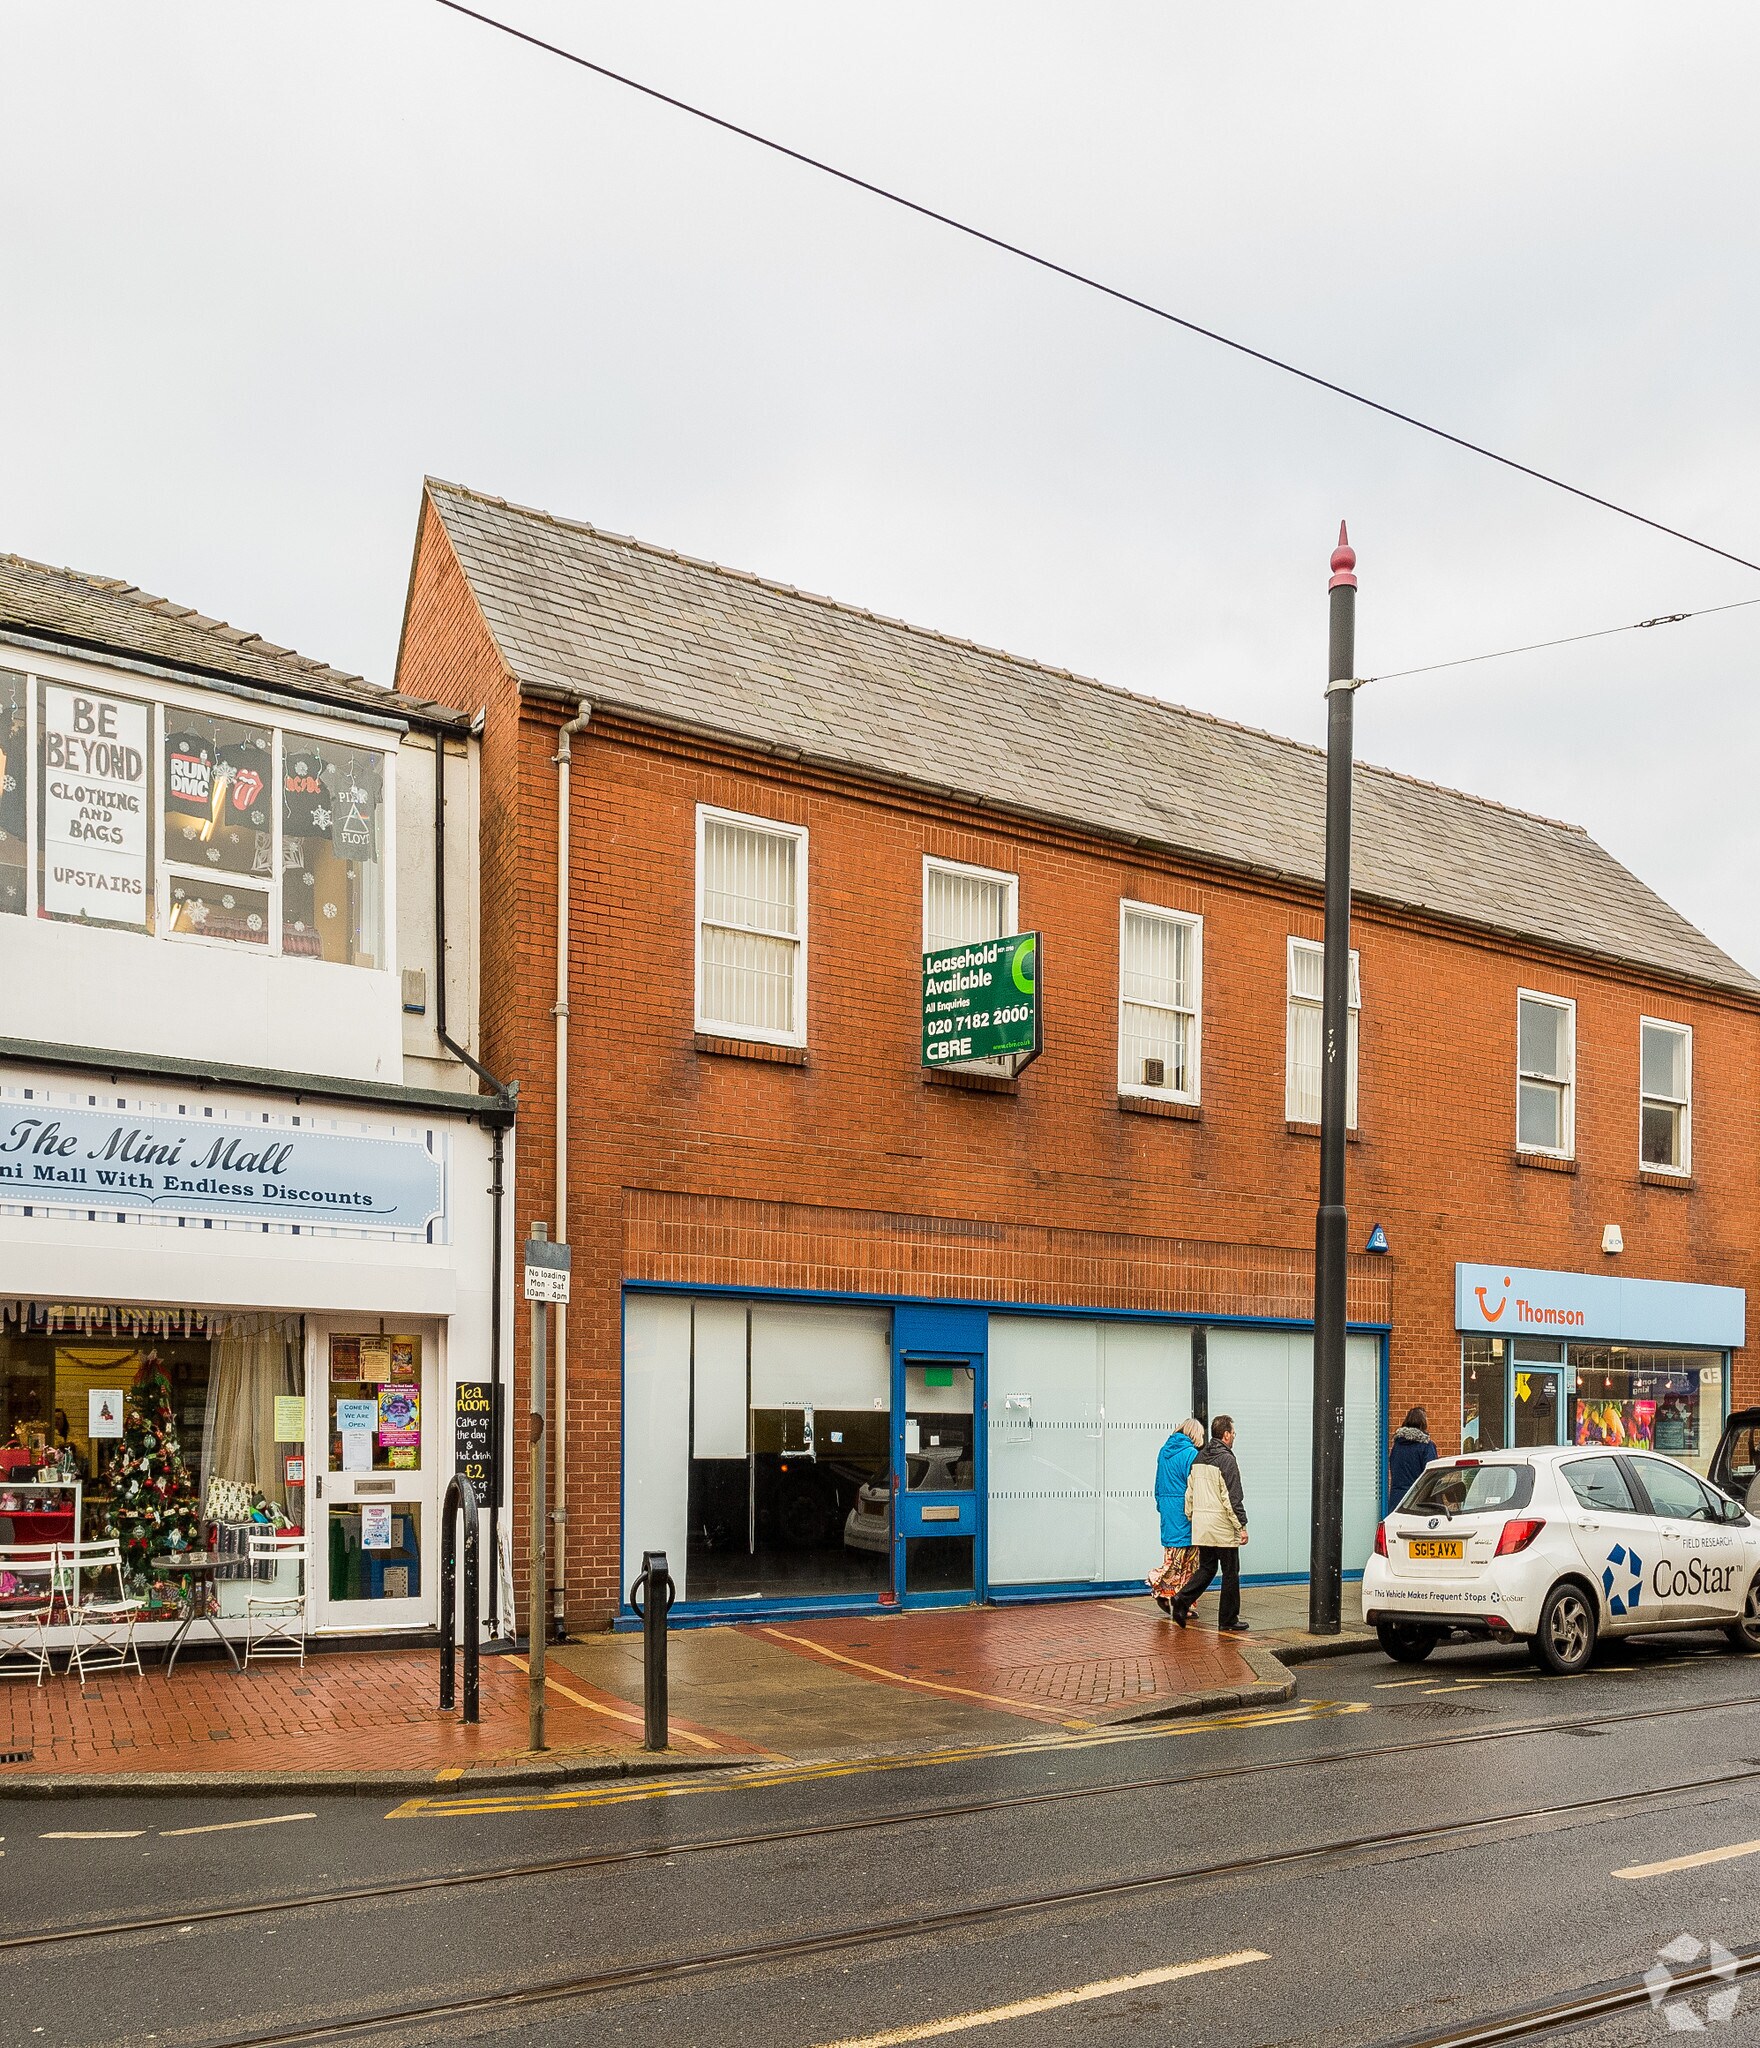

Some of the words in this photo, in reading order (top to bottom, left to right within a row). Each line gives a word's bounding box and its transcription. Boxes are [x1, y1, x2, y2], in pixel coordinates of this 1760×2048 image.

[73, 697, 118, 739] BE
[46, 731, 144, 782] BEYOND
[170, 758, 211, 779] RUN
[170, 774, 209, 797] DMC
[50, 782, 140, 813] CLOTHING
[79, 807, 113, 823] AND
[69, 819, 124, 844] BAGS
[53, 866, 143, 895] UPSTAIRS
[926, 944, 998, 975] Leasehold
[925, 968, 993, 997] Available
[925, 1003, 936, 1014] All
[937, 998, 971, 1012] Enquiries
[928, 1019, 953, 1036] 020
[955, 1013, 990, 1031] 7182
[993, 1006, 1028, 1025] 2000
[926, 1037, 972, 1060] CBRE
[0, 1119, 78, 1157] The
[87, 1127, 187, 1166] Mini
[191, 1137, 294, 1175] Mall
[33, 1164, 88, 1184] Mall
[96, 1170, 154, 1189] With
[163, 1176, 254, 1196] Endless
[262, 1183, 373, 1206] Discounts
[528, 1269, 539, 1277] No
[541, 1270, 566, 1281] loading
[530, 1279, 545, 1287] Mon
[552, 1281, 564, 1290] Sat
[526, 1288, 545, 1297] 10am
[551, 1291, 567, 1300] 4pm
[1515, 1299, 1585, 1326] Thomson
[457, 1383, 483, 1400] Tea
[456, 1417, 478, 1428] Cake
[480, 1418, 490, 1430] of
[457, 1430, 470, 1440] the
[471, 1428, 486, 1443] day
[466, 1441, 473, 1450] &
[456, 1450, 471, 1460] Hot
[472, 1450, 491, 1460] drink
[465, 1464, 485, 1478] £2
[1414, 1543, 1435, 1556] SG15
[1438, 1543, 1457, 1556] AVX
[1682, 1538, 1700, 1549] FIELD
[1701, 1537, 1733, 1548] RESEARCH
[1653, 1557, 1735, 1598] CoStar
[1374, 1589, 1385, 1598] This
[1386, 1589, 1406, 1599] Vehicle
[1407, 1591, 1428, 1600] Makes
[1429, 1591, 1462, 1602] Frequent
[1464, 1592, 1487, 1603] Stops
[1501, 1594, 1524, 1602] CoStar
